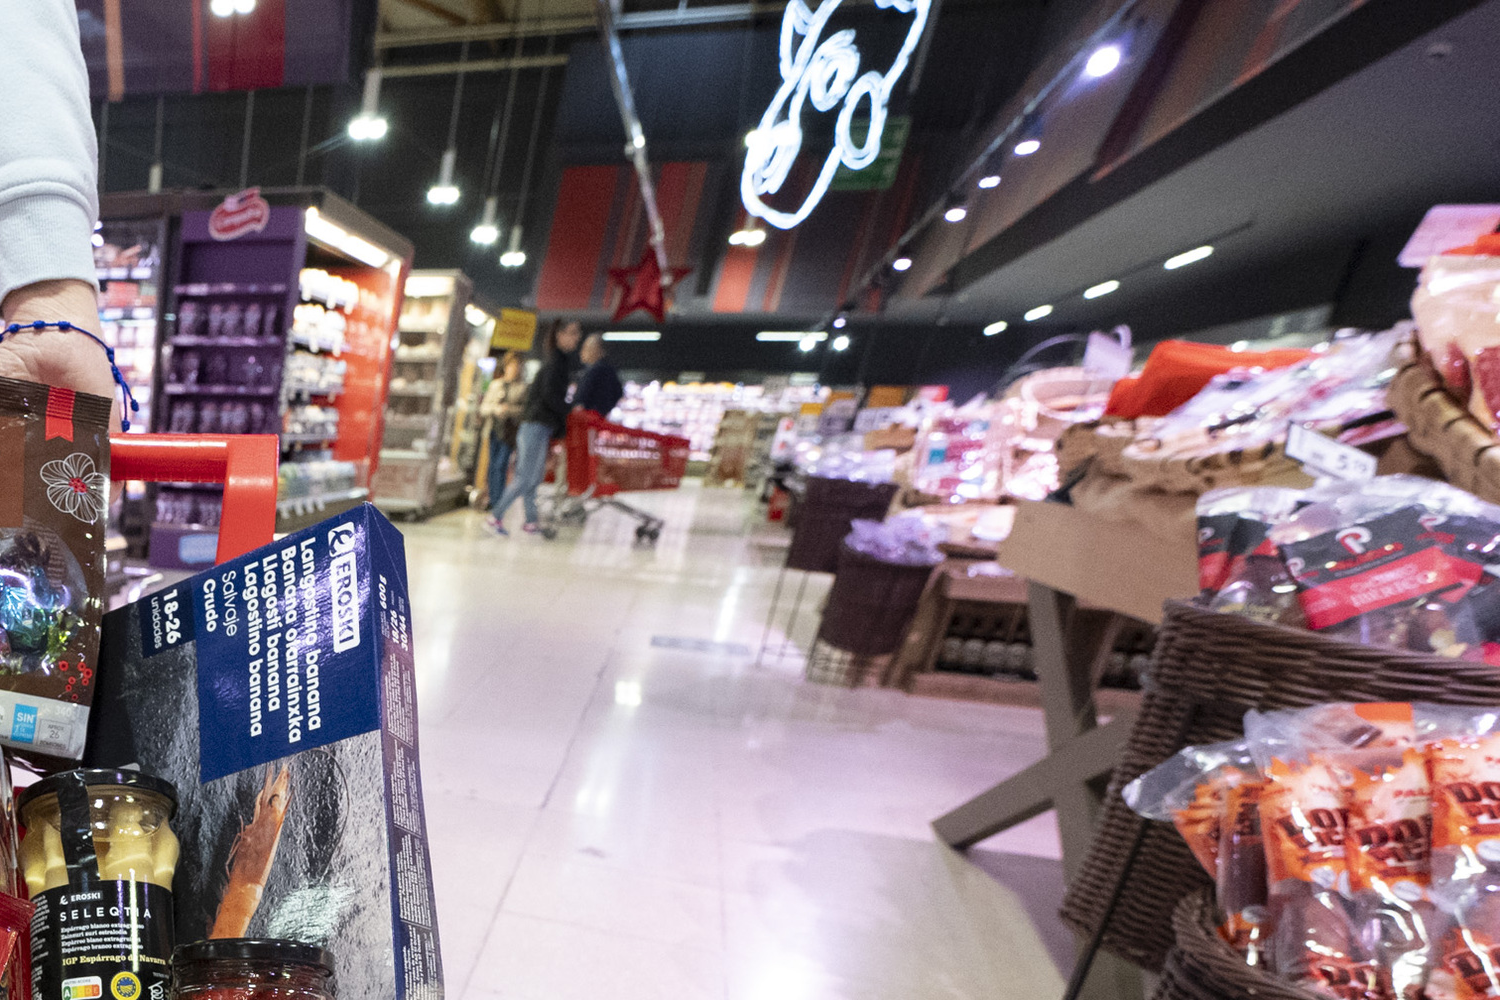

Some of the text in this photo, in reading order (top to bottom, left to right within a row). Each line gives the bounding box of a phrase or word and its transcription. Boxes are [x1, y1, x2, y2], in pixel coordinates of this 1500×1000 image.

[203, 578, 218, 632] Crudo
[222, 570, 240, 636] Salvaje
[281, 545, 298, 625] Banana
[335, 561, 355, 644] EROSKI
[150, 596, 162, 649] unidades
[163, 589, 181, 645] 18-26
[261, 553, 283, 712] Llagostí banana
[299, 536, 321, 731] Langostino banana
[242, 561, 263, 737] Lagostino banana
[16, 712, 34, 723] SIN
[49, 730, 60, 739] 26
[70, 893, 101, 902] EROSKI
[61, 924, 89, 933] Espárrago
[62, 957, 78, 966] IGP
[80, 955, 126, 964] Espárrago
